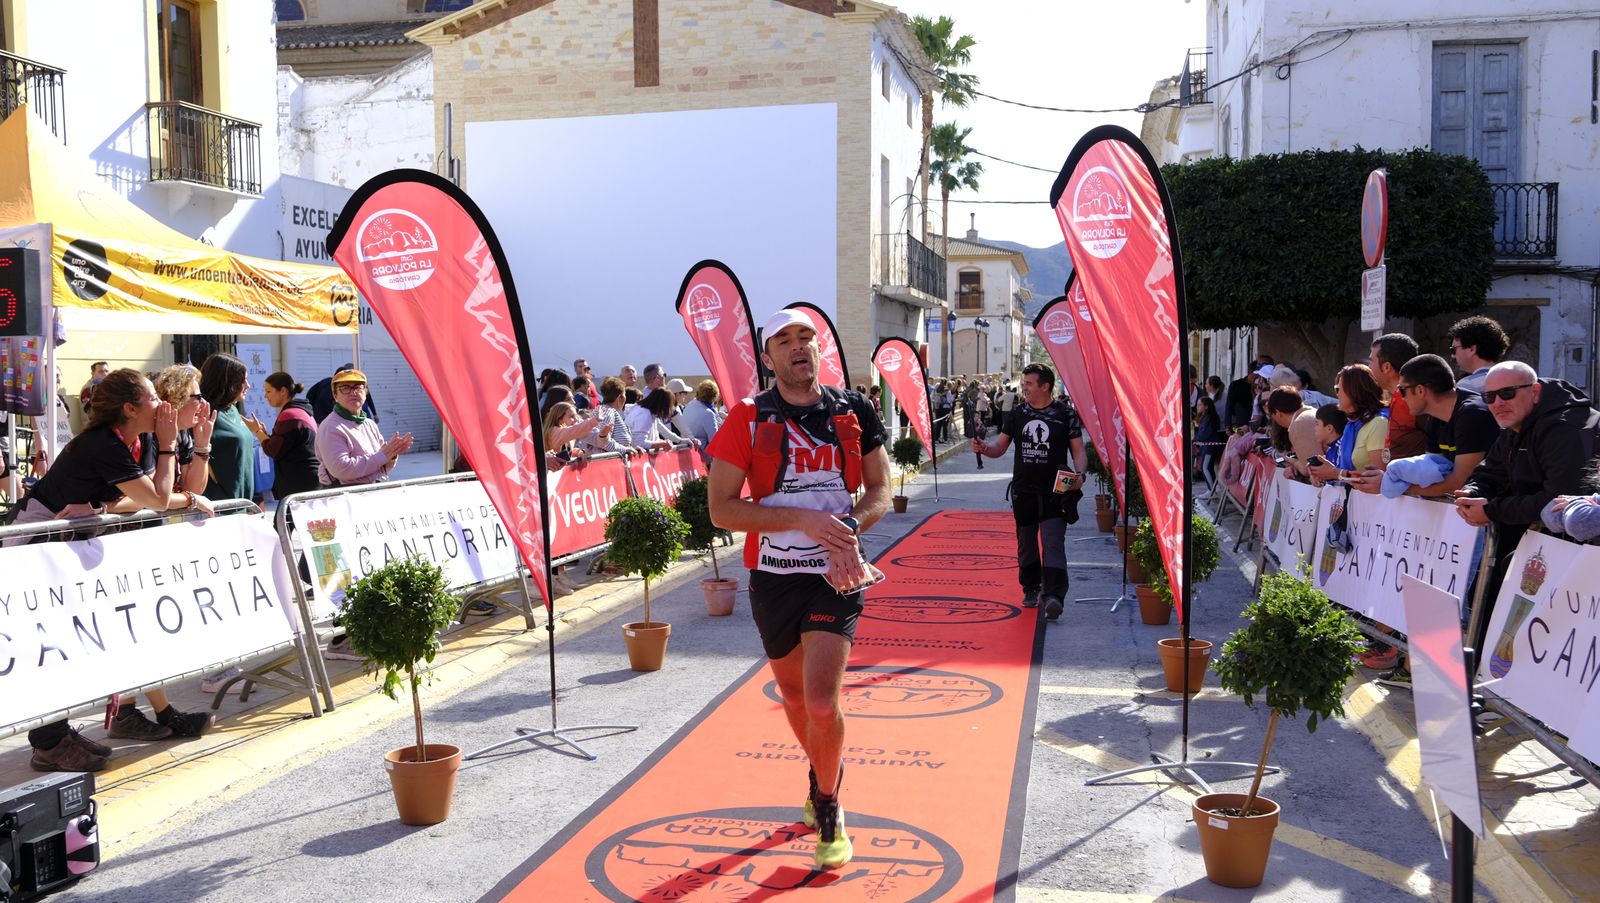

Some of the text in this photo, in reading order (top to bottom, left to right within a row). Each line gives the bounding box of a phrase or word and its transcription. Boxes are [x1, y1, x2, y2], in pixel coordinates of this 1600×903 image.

[557, 485, 618, 528] VEOLIA
[355, 504, 498, 539] AYUNTAMIENTO DE
[230, 548, 257, 570] DE
[358, 522, 508, 578] CANTORIA
[1438, 542, 1460, 564] DE
[1541, 587, 1600, 620] YUN
[855, 642, 984, 650] Ayuntamien
[844, 676, 932, 684] POLVO
[736, 751, 945, 769] Ayuntaiento
[762, 742, 932, 758] de Caria
[664, 823, 921, 850] LA OLVORA
